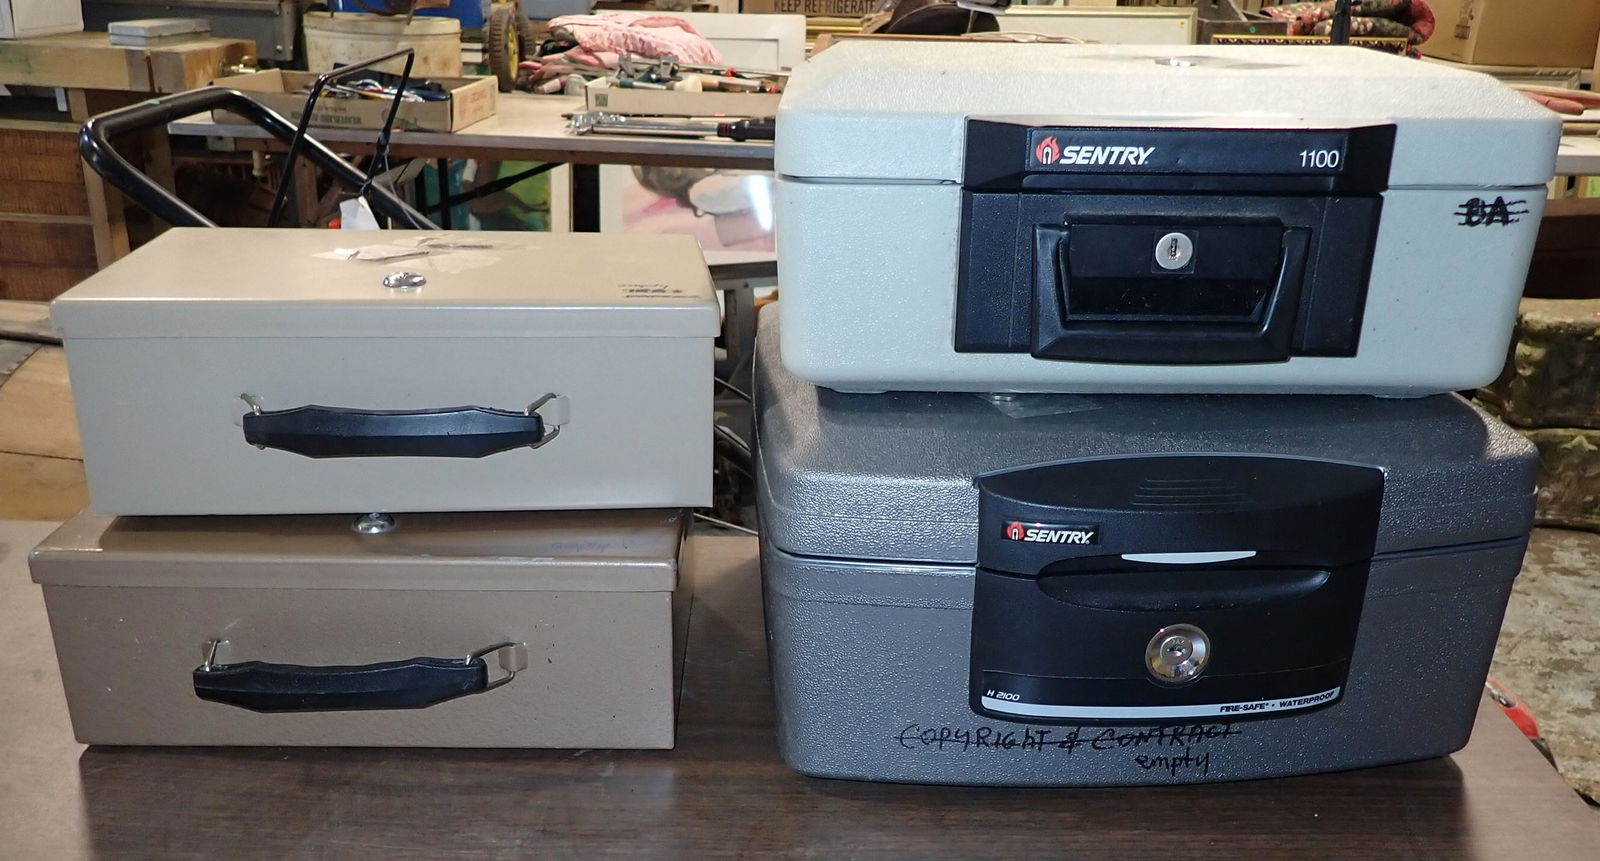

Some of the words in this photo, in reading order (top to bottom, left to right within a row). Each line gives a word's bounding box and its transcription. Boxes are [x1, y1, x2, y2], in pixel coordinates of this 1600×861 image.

[774, 0, 800, 12] KEEP
[1299, 149, 1340, 168] 1100
[986, 689, 995, 697] H
[995, 691, 1021, 701] 2100
[1279, 690, 1335, 708] WATERPROOF
[1135, 747, 1210, 776] empty
